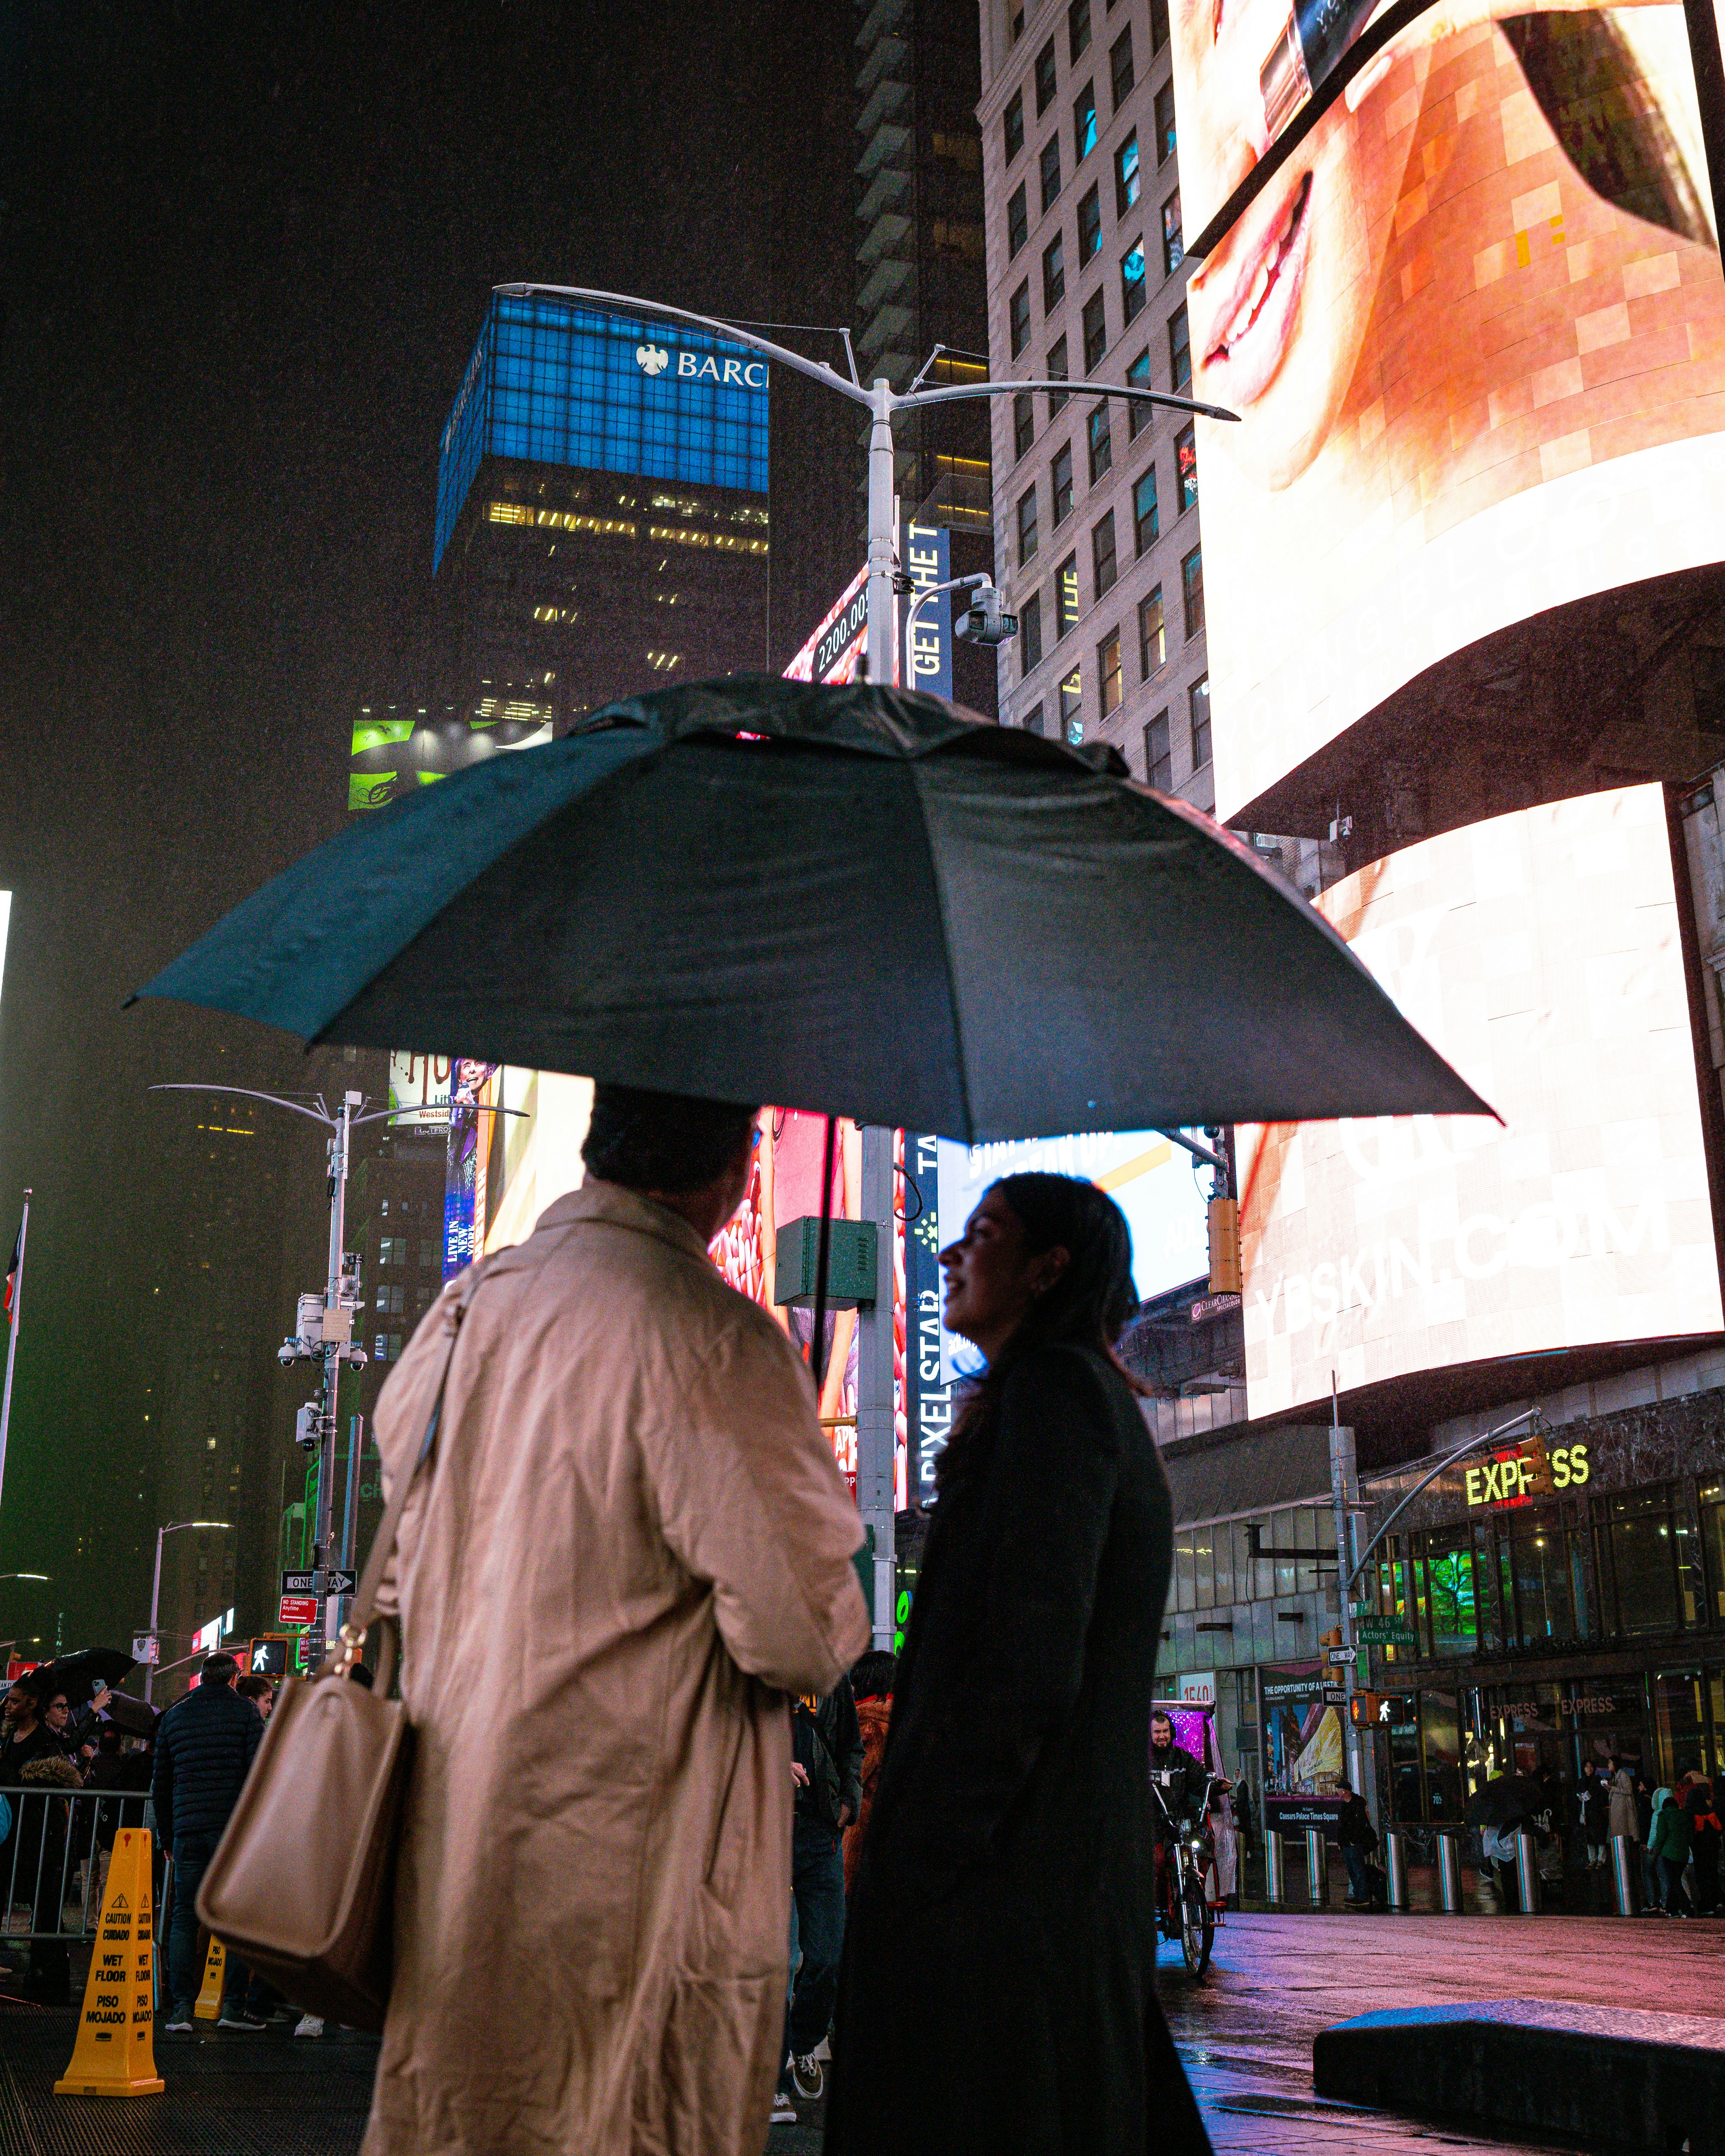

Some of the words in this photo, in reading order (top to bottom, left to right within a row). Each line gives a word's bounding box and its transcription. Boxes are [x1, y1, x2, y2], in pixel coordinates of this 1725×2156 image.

[678, 352, 769, 388] BARC
[449, 1221, 459, 1234] IN
[458, 1227, 468, 1254] NEW
[1163, 1211, 1206, 1259] ADL
[447, 1236, 458, 1263] LIVE
[1466, 1445, 1589, 1505] EXPRSS
[293, 1578, 313, 1587] ONE
[1366, 1618, 1373, 1628] W
[1378, 1617, 1390, 1628] 46
[1391, 1632, 1414, 1642] Equity
[1331, 1652, 1340, 1661] ONE
[1344, 1651, 1353, 1659] WAY
[1264, 1686, 1274, 1695] THE
[1274, 1682, 1308, 1694] OPPORTUNITY
[1308, 1682, 1315, 1691] OF
[1315, 1682, 1320, 1691] A
[1331, 1692, 1345, 1701] ONE
[1490, 1702, 1539, 1719] EXPRESS
[1562, 1697, 1613, 1715] EXPRESS
[1323, 1812, 1338, 1822] Square
[105, 1913, 131, 1924] CAUTION
[138, 1913, 151, 1924] CAUTION
[103, 1930, 129, 1941] CUIDADO
[138, 1929, 151, 1941] CUIDADO
[103, 1954, 123, 1966] WET
[138, 1954, 149, 1966] WET
[95, 1970, 126, 1982] FLOOR
[136, 1970, 151, 1982] FLOOR
[96, 1995, 119, 2008] PISO
[137, 1994, 148, 2007] PISO
[86, 2011, 126, 2024] MOJADO
[132, 2010, 151, 2024] MOJADO
